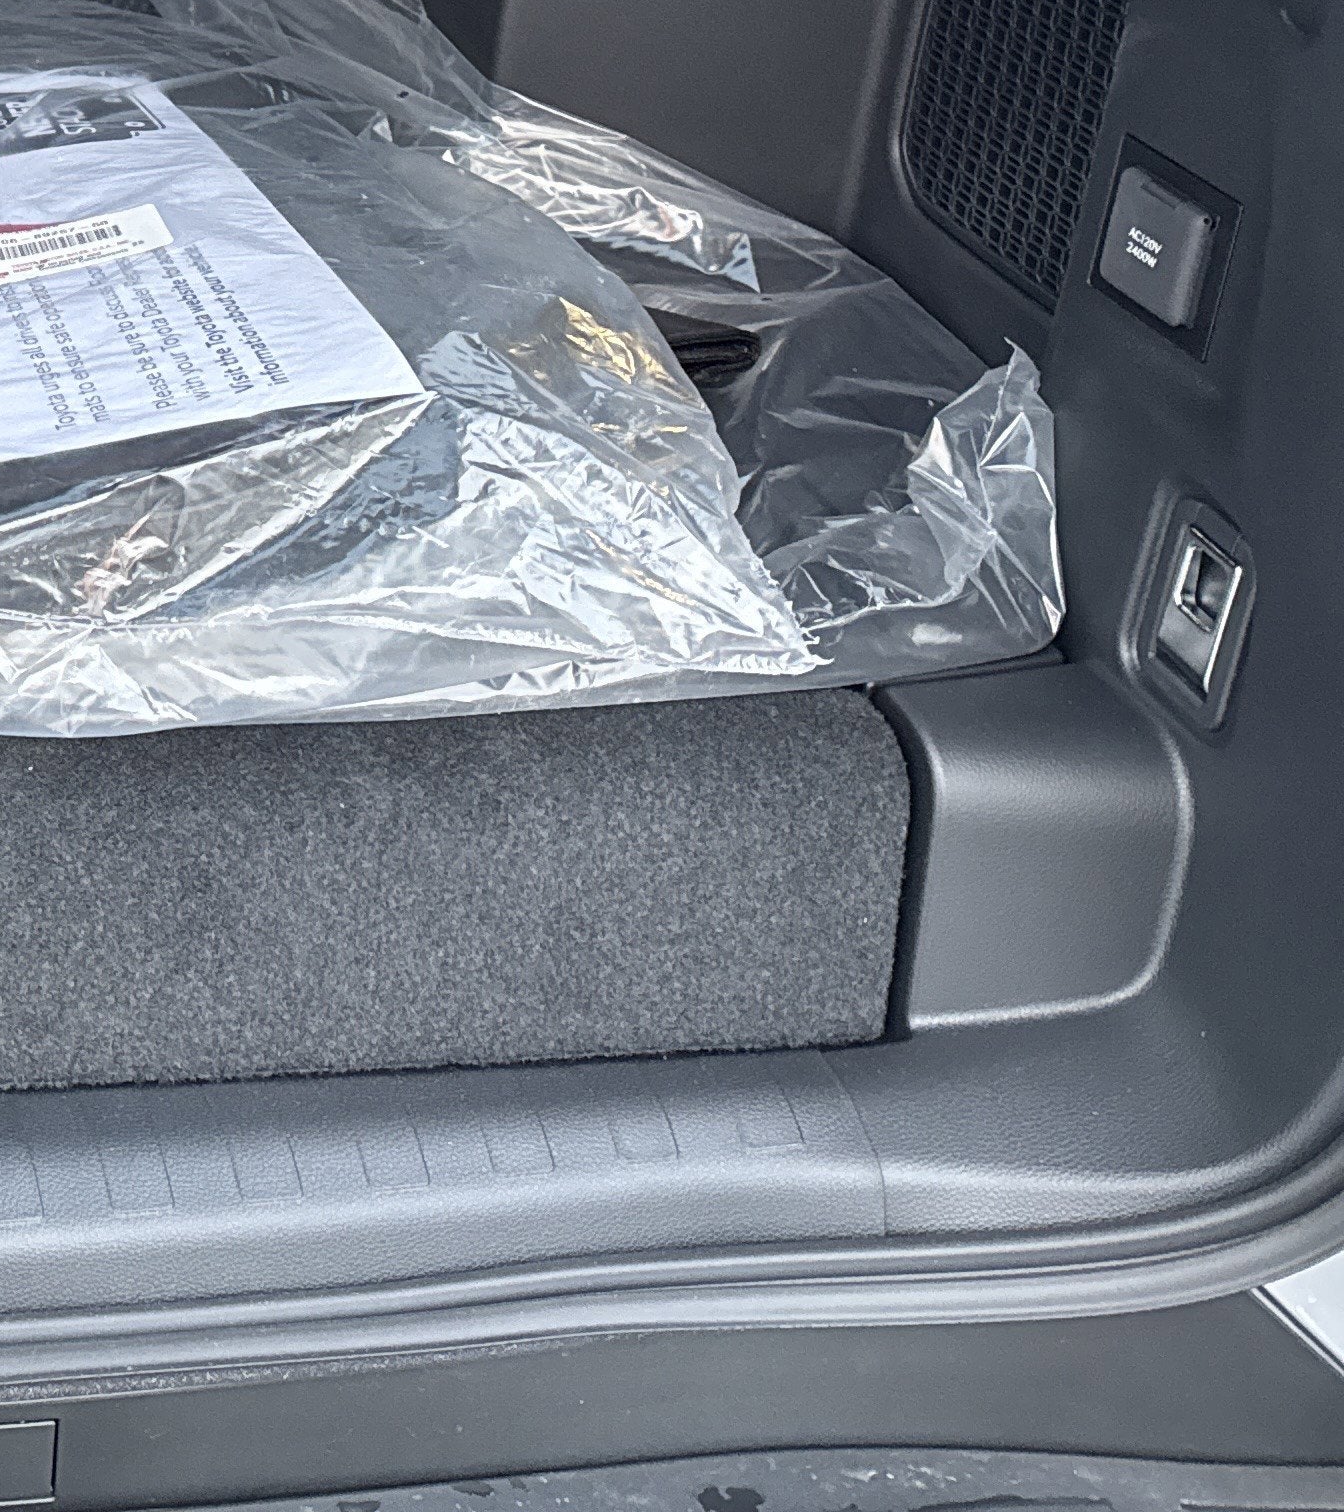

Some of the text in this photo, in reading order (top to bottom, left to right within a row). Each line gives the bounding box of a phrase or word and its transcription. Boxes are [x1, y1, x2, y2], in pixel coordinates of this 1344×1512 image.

[1126, 241, 1157, 267] 2400W
[1128, 227, 1163, 254] AC120V
[171, 278, 205, 314] website
[204, 276, 235, 296] your
[215, 296, 248, 324] about
[45, 322, 72, 344] safe
[117, 321, 136, 333] to
[151, 318, 182, 352] Toyota
[195, 313, 226, 348] Toyota
[21, 346, 46, 360] all
[125, 333, 150, 355] sure
[215, 347, 239, 366] the
[238, 324, 290, 386] information
[62, 345, 89, 380] ensure
[136, 356, 157, 373] be
[170, 352, 203, 375] your
[34, 361, 61, 392] urges
[78, 382, 97, 395] to
[152, 371, 177, 409] Please
[181, 376, 211, 401] with
[224, 366, 254, 394] Visit
[47, 393, 78, 430] Toyota
[84, 395, 110, 422] mats
